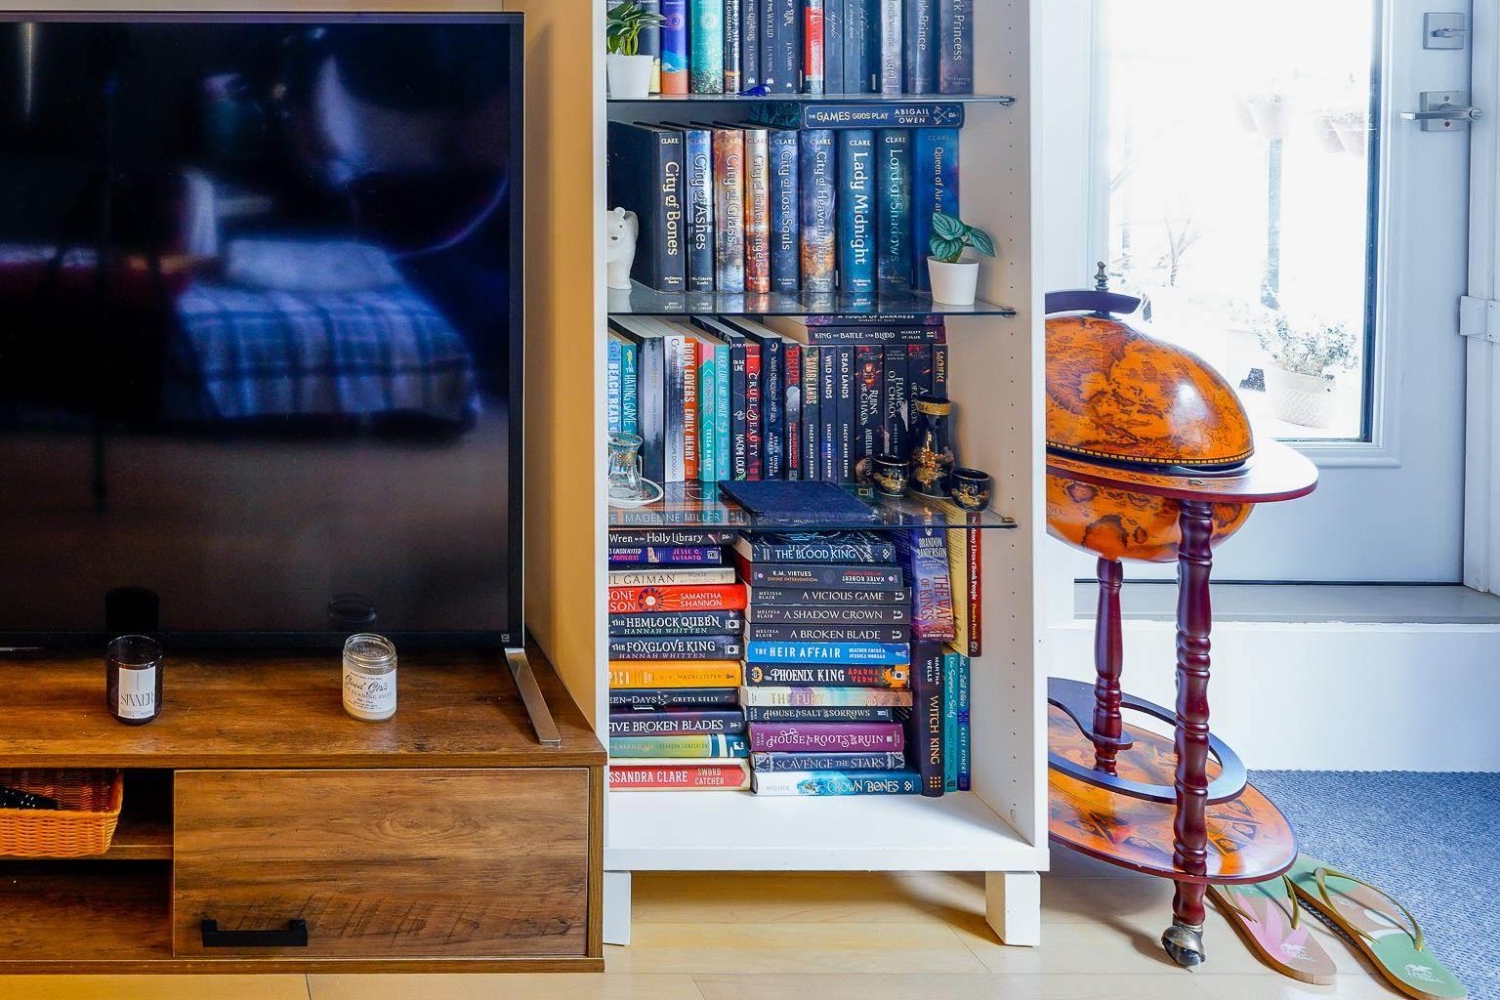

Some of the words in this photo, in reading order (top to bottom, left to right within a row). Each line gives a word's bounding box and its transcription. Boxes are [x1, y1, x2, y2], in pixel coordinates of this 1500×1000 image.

[918, 15, 929, 50] Prince
[953, 15, 965, 60] Princess
[816, 111, 850, 122] GAMES
[872, 112, 889, 120] PLAY
[778, 150, 792, 177] City
[851, 152, 868, 191] Lady
[663, 161, 680, 193] City
[780, 178, 792, 190] of
[665, 195, 676, 209] of
[782, 191, 792, 216] Lost
[667, 211, 681, 256] Bones
[695, 205, 708, 250] Ashes
[781, 218, 793, 250] Souls
[851, 194, 870, 265] Midnight
[684, 342, 694, 366] BOOK
[786, 347, 799, 385] BRIDE
[841, 353, 849, 373] DEAD
[624, 373, 636, 401] HATING
[684, 368, 694, 403] LOVERS
[749, 370, 760, 409] CRUEL
[841, 375, 849, 399] LANDS
[624, 402, 636, 426] GAME
[684, 408, 695, 433] EMILY
[747, 410, 758, 456] BEAUTY
[684, 435, 695, 461] HENRY
[610, 534, 633, 543] Wren
[646, 533, 670, 543] Holly
[672, 533, 703, 544] Library
[775, 550, 794, 559] THE
[796, 550, 829, 559] BLOOD
[831, 550, 856, 559] KING
[624, 574, 675, 584] GAIMAN
[802, 592, 809, 600] A
[811, 592, 853, 600] VICIOUS
[855, 592, 884, 600] GAME
[626, 617, 680, 628] HEMLOCK
[681, 615, 721, 628] QUEEN
[784, 610, 791, 619] A
[793, 610, 839, 619] SHADOW
[842, 610, 883, 619] CROWN
[626, 639, 685, 653] FOXGLOVE
[687, 642, 715, 652] KING
[790, 630, 797, 638] A
[800, 630, 844, 639] BROKEN
[847, 631, 881, 639] BLADE
[770, 647, 796, 657] HEIR
[800, 647, 841, 658] AFFAIR
[771, 668, 814, 682] PHOENIX
[817, 669, 845, 682] KING
[632, 720, 678, 733] BROKEN
[682, 720, 724, 730] BLADES
[764, 709, 795, 720] HOUSE
[802, 709, 822, 717] SALT
[829, 709, 870, 719] SORROWS
[930, 696, 939, 733] WITCH
[766, 728, 806, 747] HOUSE
[814, 735, 850, 747] ROOTS
[858, 735, 883, 746] RUIN
[776, 758, 833, 769] SCAVENGE
[851, 757, 885, 768] STARS
[930, 738, 940, 764] KING
[657, 771, 688, 782] CLARE
